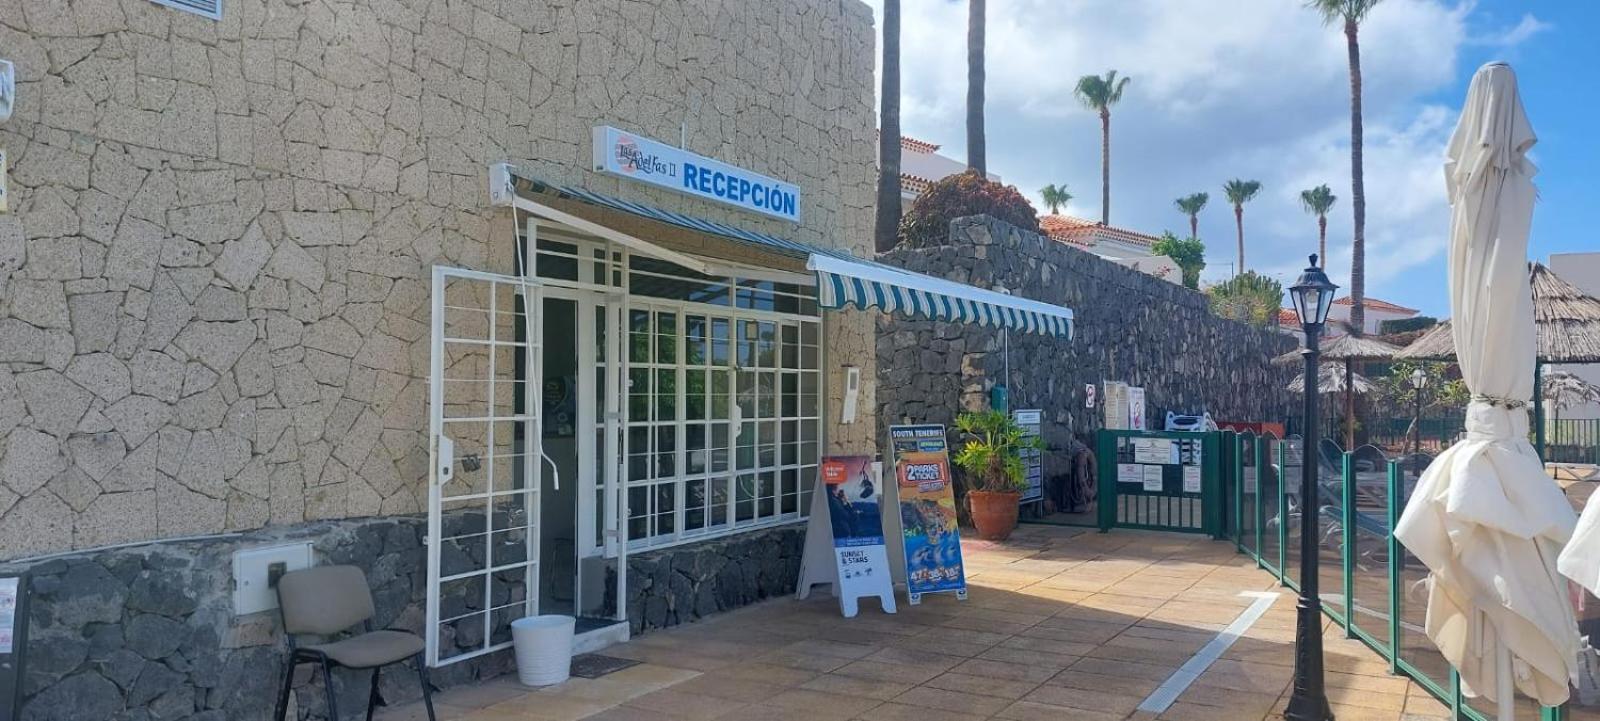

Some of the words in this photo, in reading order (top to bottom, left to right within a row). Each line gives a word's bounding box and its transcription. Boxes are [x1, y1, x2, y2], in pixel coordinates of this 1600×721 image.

[620, 145, 632, 159] Las
[683, 162, 796, 216] RECEPCIÓN
[893, 430, 914, 438] SOUTH
